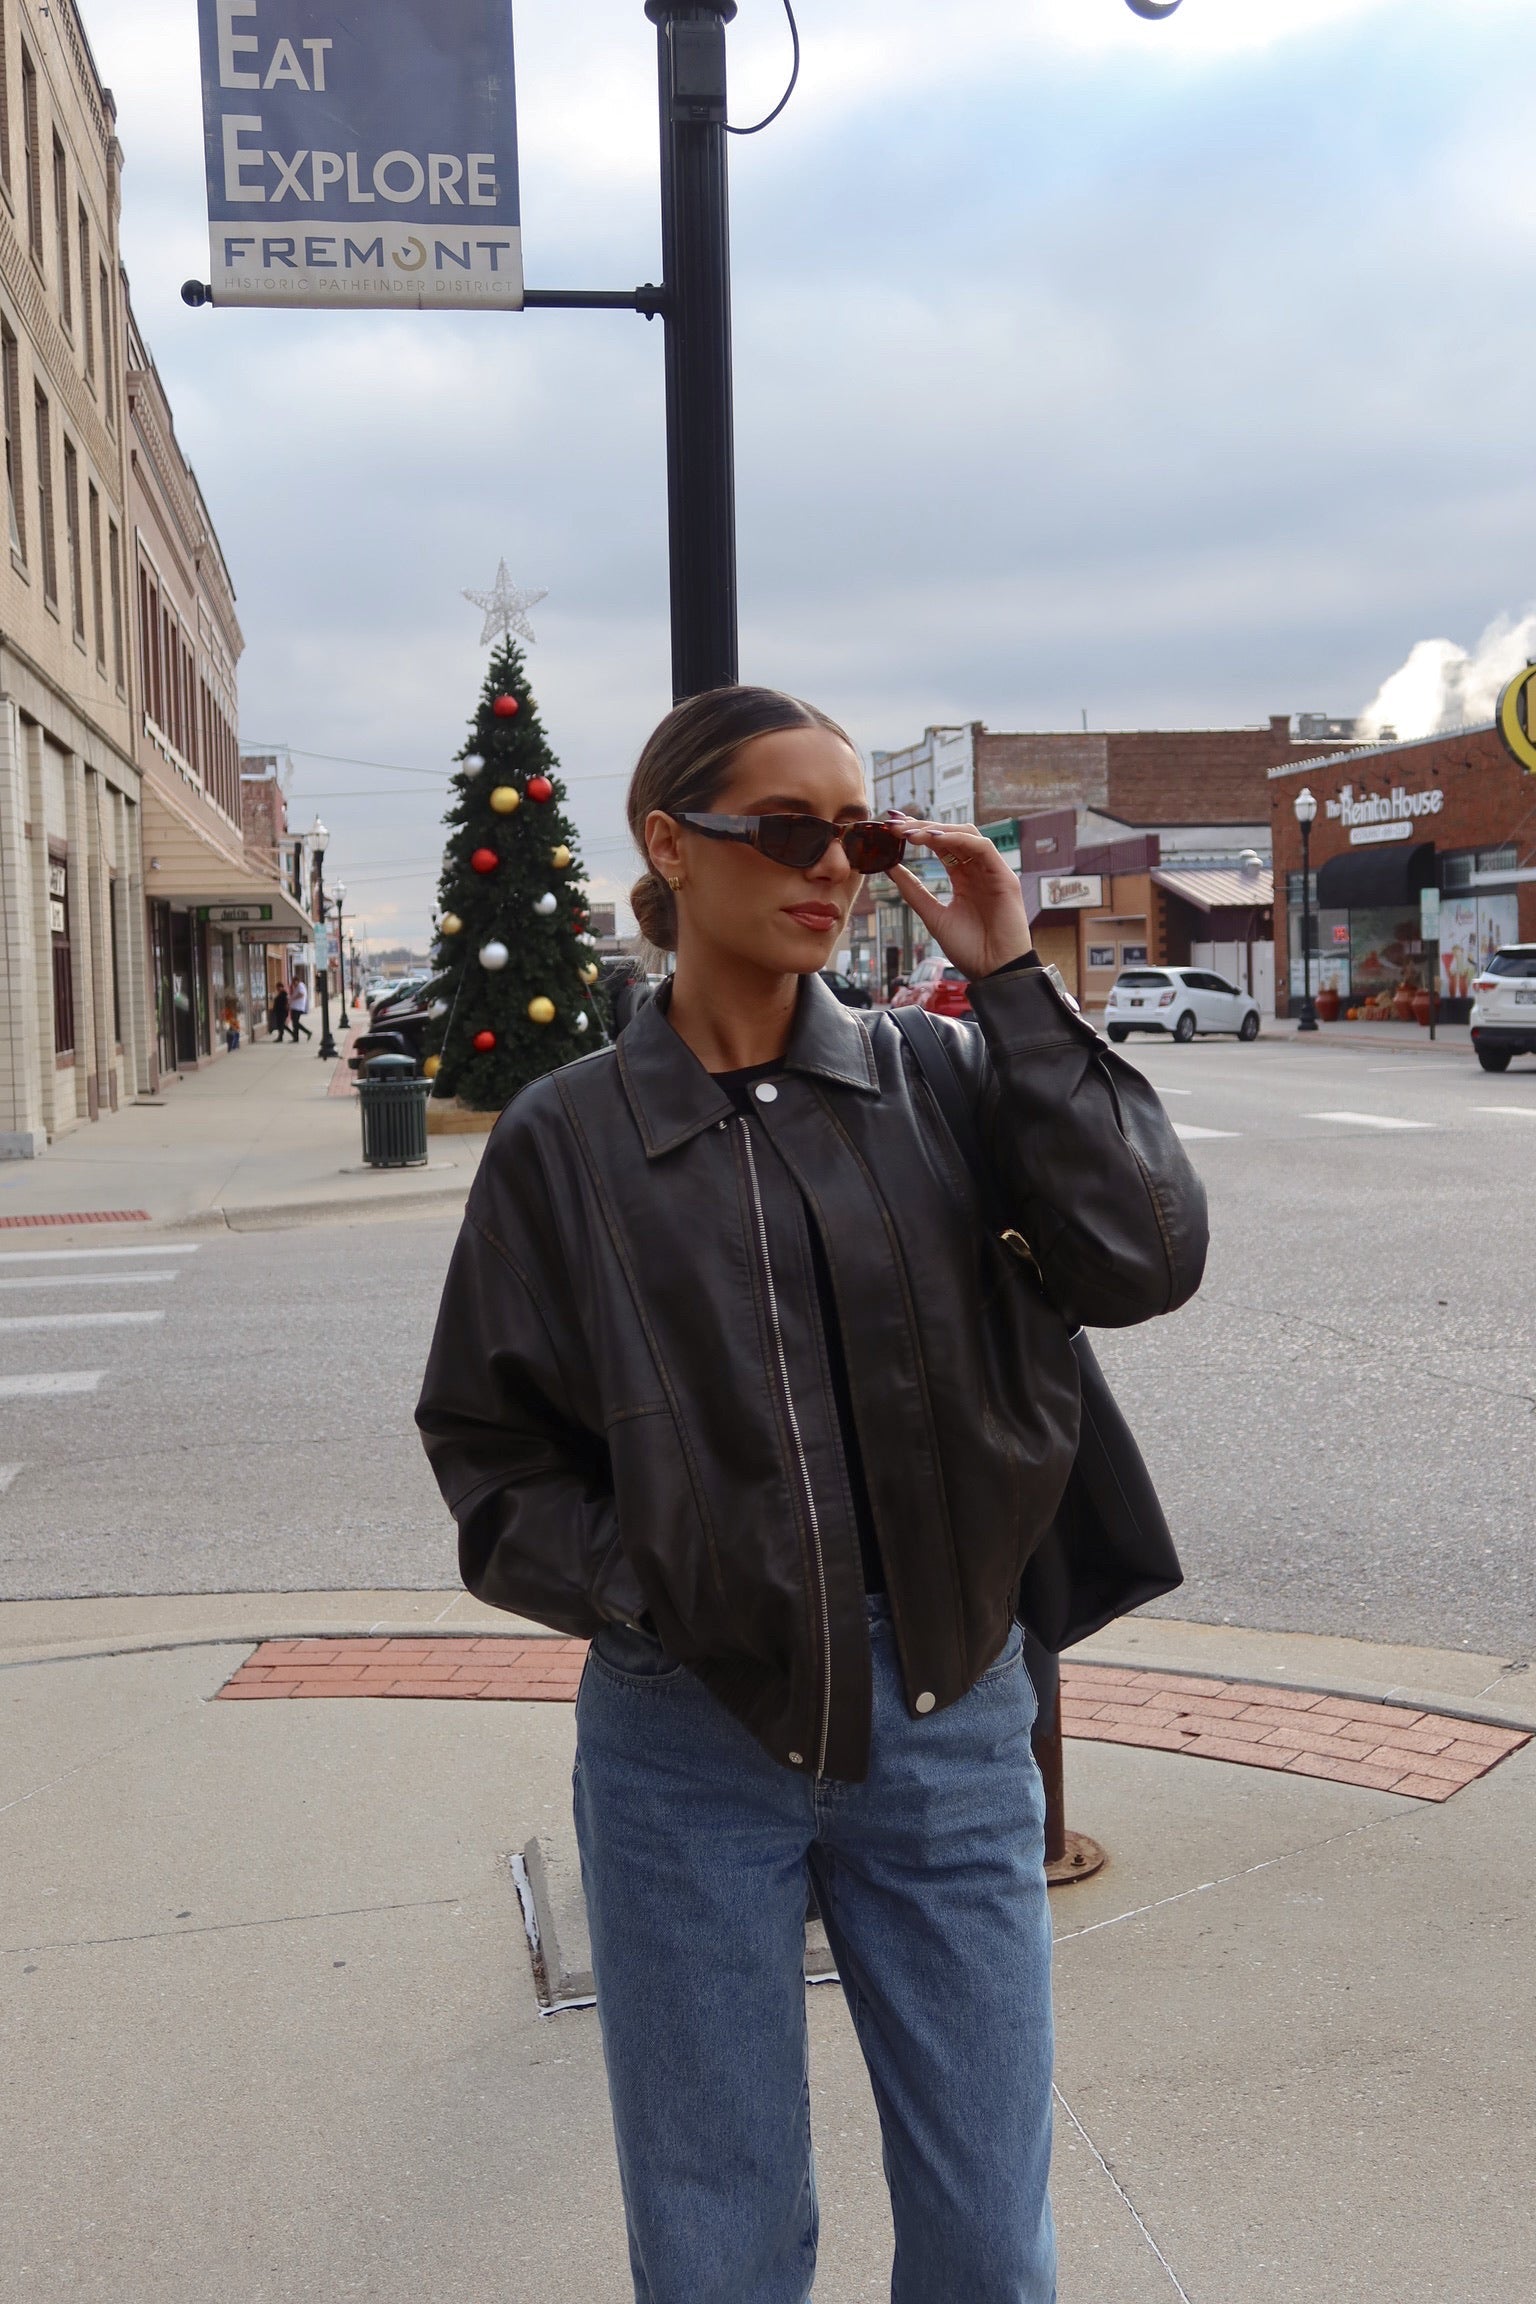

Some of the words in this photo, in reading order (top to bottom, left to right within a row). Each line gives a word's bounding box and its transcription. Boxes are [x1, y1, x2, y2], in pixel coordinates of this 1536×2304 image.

[216, 0, 333, 92] EAT
[221, 114, 498, 206] EXPLORE
[224, 236, 510, 272] FREMONT
[224, 278, 310, 291] HISTORIC
[318, 279, 426, 292] PATHFINDER
[435, 280, 514, 293] DISTRICT
[1325, 799, 1341, 818] The
[1391, 787, 1444, 818] House
